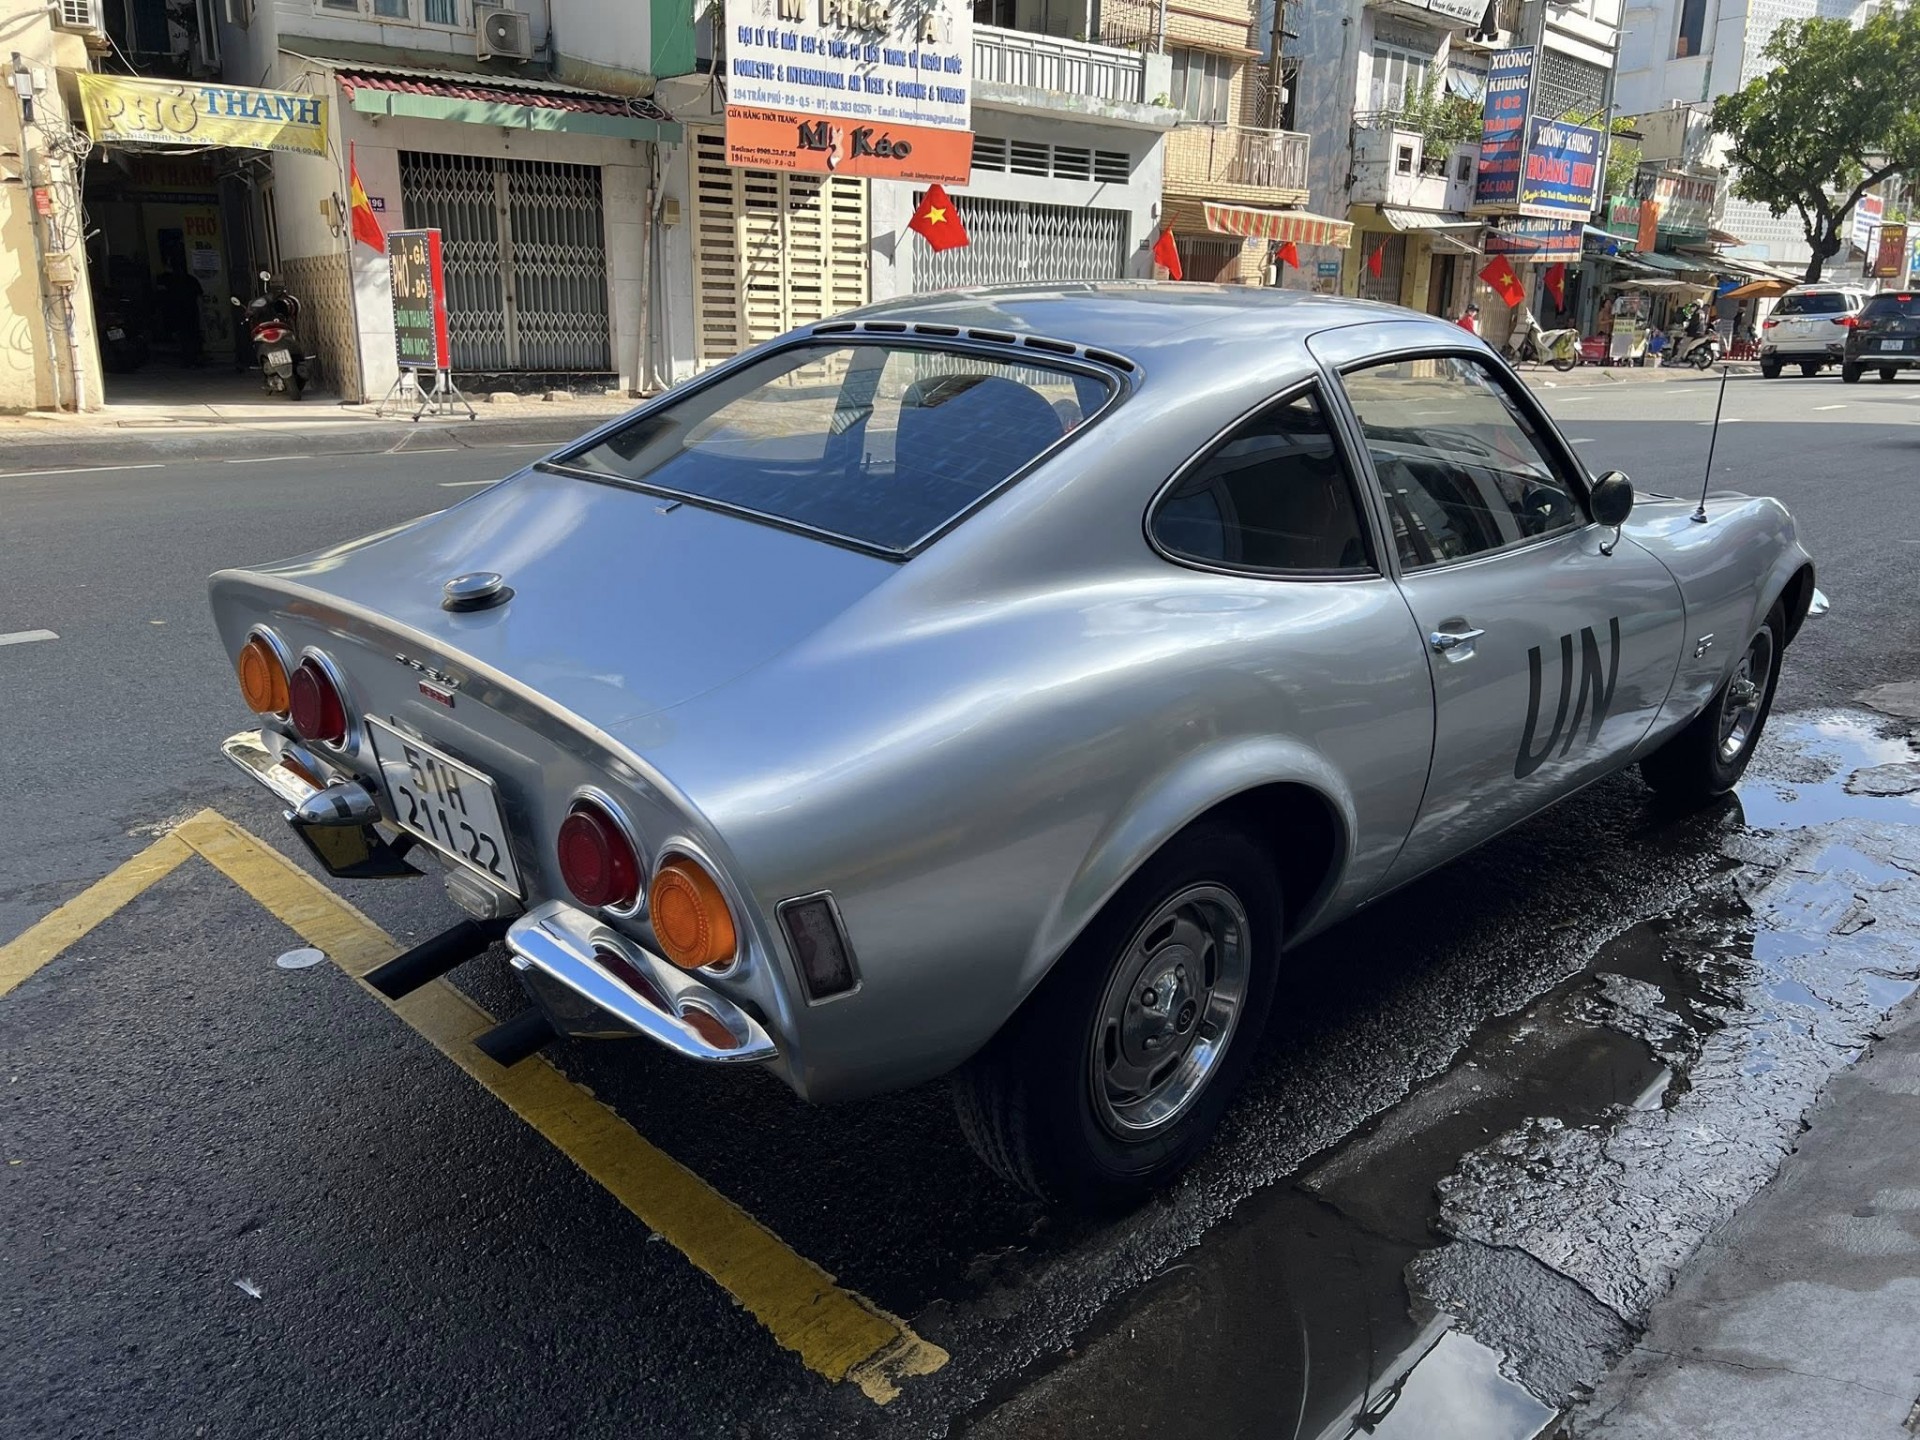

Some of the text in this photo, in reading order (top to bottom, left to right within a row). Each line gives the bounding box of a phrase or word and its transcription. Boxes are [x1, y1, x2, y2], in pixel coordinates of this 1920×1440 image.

[755, 25, 765, 46] LÝ
[781, 29, 799, 52] MÁY
[801, 34, 817, 55] BAY
[883, 47, 907, 67] TRONG
[1491, 49, 1532, 70] XƯỞNG
[733, 57, 775, 81] DOMESTIC
[777, 64, 784, 82] &
[786, 65, 846, 91] INTERNATIONAL
[848, 74, 861, 92] AIR
[895, 80, 927, 101] BOOKING
[936, 85, 966, 105] TOURISM
[733, 88, 747, 100] 194
[1489, 74, 1529, 92] KHUNG
[201, 87, 322, 125] THANH
[727, 106, 741, 118] CỬA
[743, 110, 761, 120] HÀNG
[777, 114, 798, 125] TRANG
[1495, 95, 1522, 110] 182
[849, 125, 912, 161] Káo
[1537, 122, 1593, 154] XƯỞNG KHUNG
[1526, 151, 1595, 188] HOÀNG HUY
[1526, 218, 1555, 232] KHUNG
[391, 238, 426, 298] PHỞ GÀ
[415, 274, 428, 298] BÒ
[397, 306, 430, 328] BÚN THANG
[402, 333, 430, 360] BÚN MỌC
[1514, 616, 1621, 780] UN
[403, 744, 468, 816] 51H
